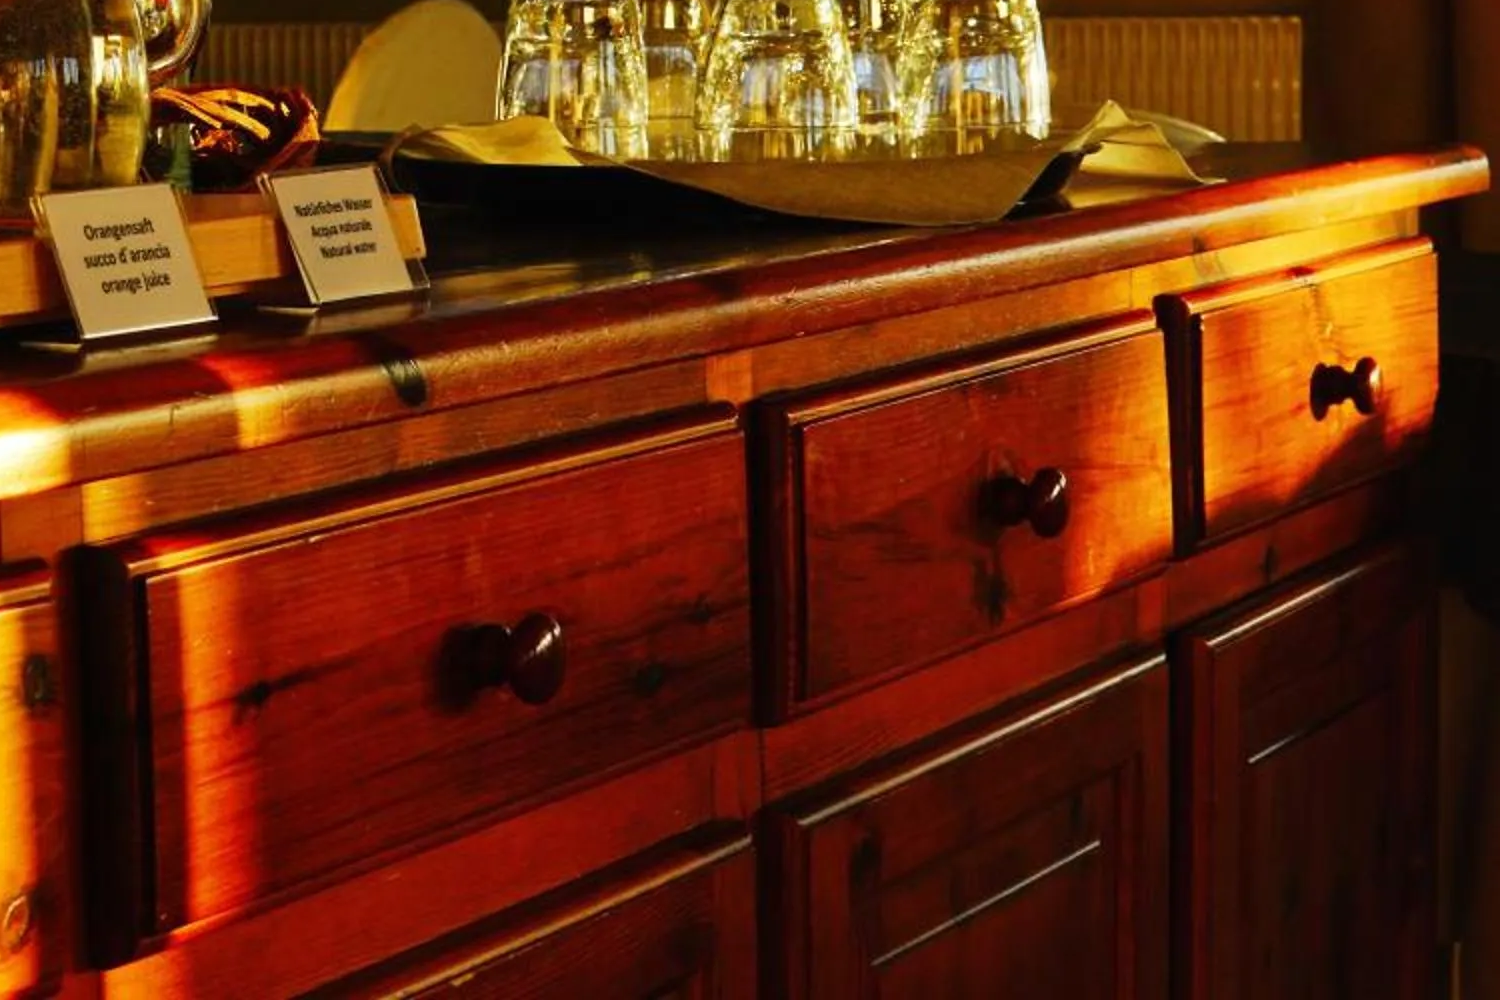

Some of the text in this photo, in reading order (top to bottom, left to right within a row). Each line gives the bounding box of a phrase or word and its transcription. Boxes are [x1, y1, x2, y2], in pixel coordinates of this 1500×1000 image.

[83, 217, 154, 241] Orangensaft
[84, 252, 117, 269] succo
[101, 271, 171, 294] orange juice
